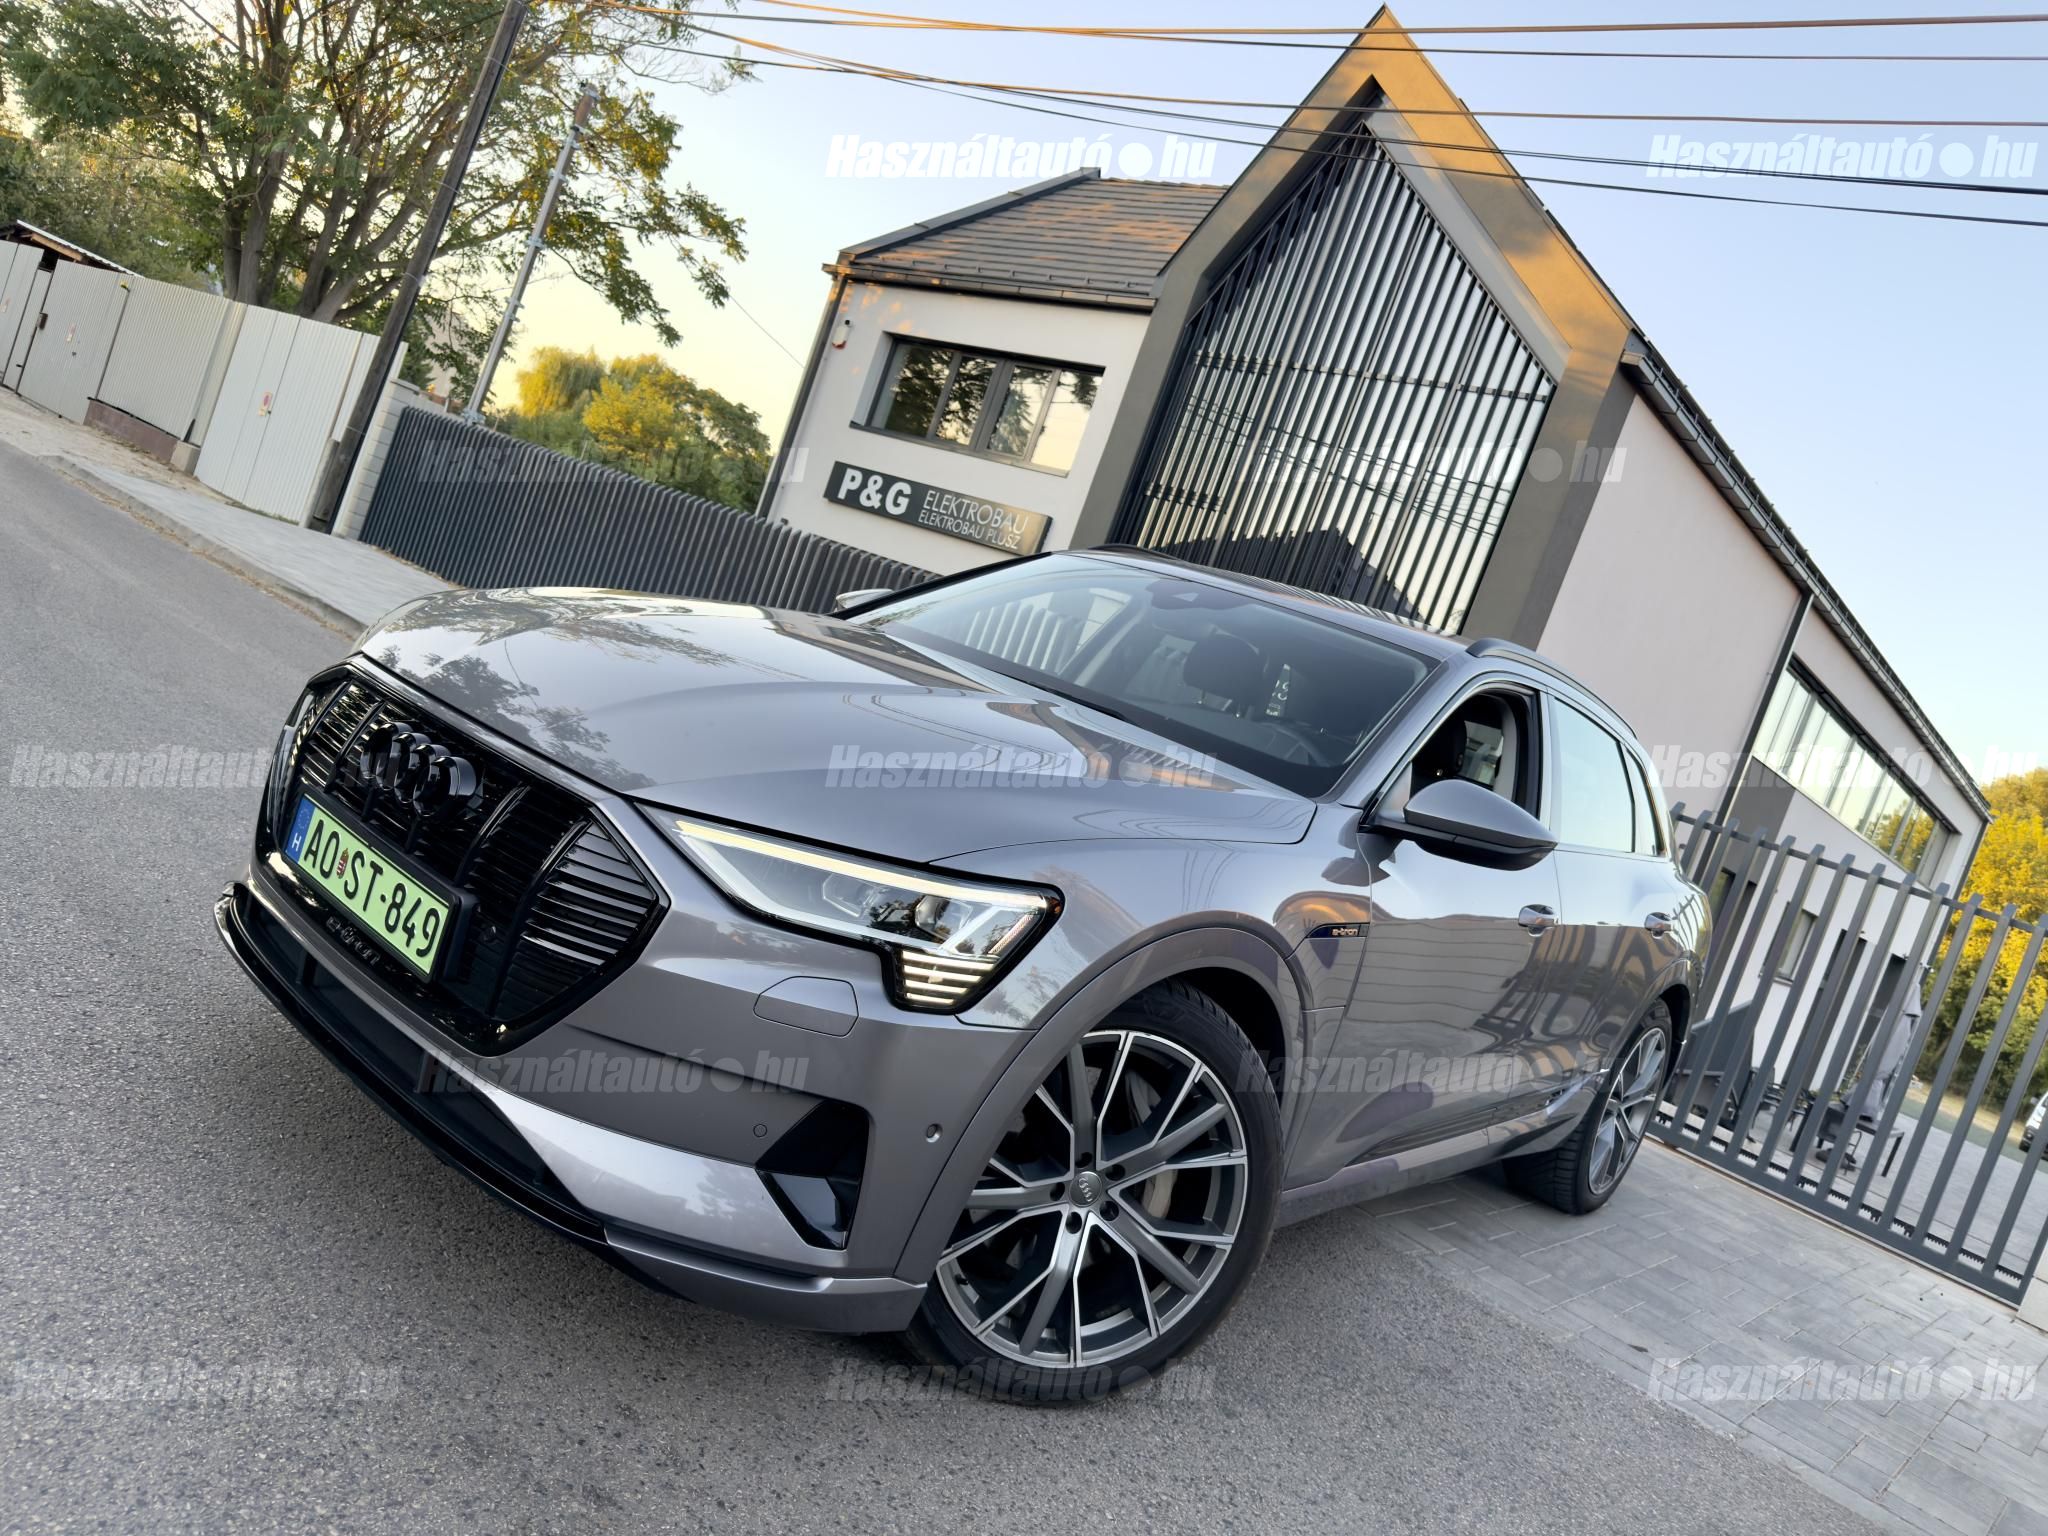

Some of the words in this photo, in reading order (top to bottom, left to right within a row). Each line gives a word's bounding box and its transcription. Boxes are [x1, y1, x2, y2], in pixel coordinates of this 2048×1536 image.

[837, 468, 912, 516] P&G
[918, 511, 983, 539] ELEKTROBAU
[986, 525, 1021, 550] PLUSZ
[922, 490, 1029, 534] ELEKTROBAU
[292, 834, 303, 851] H
[1332, 927, 1358, 936] e-tron
